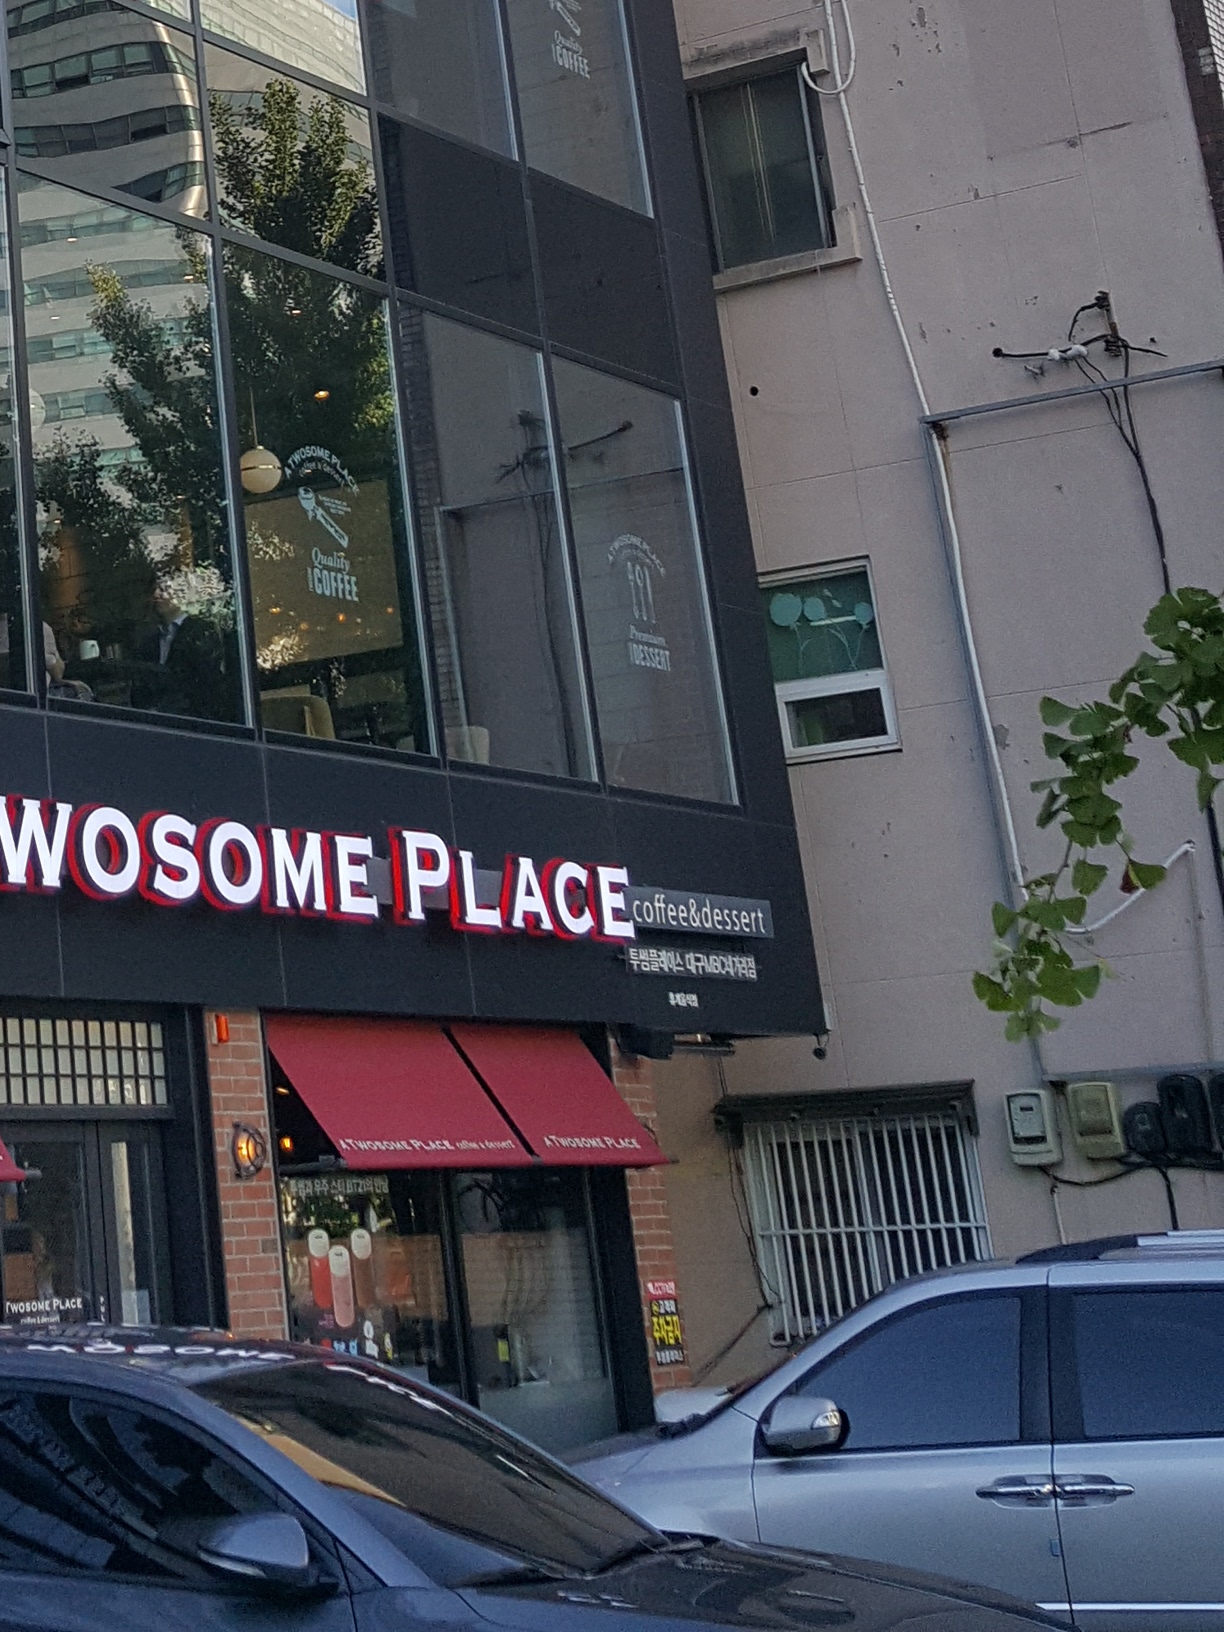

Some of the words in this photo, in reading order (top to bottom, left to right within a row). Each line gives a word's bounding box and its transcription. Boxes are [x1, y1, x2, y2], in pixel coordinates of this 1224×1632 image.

[287, 445, 331, 469] TWOSOME
[331, 454, 360, 497] PLACE
[312, 547, 351, 574] Quality
[313, 567, 359, 602] COFFEE
[392, 827, 635, 941] PLACE
[632, 893, 766, 934] coffee&dessert
[629, 948, 684, 972] 투썸플레이스
[344, 1138, 412, 1151] TWOSOME
[410, 1139, 455, 1151] PLACE
[551, 1135, 606, 1149] TWOSOME
[604, 1137, 641, 1149] PLACE
[52, 1297, 83, 1311] PLACE
